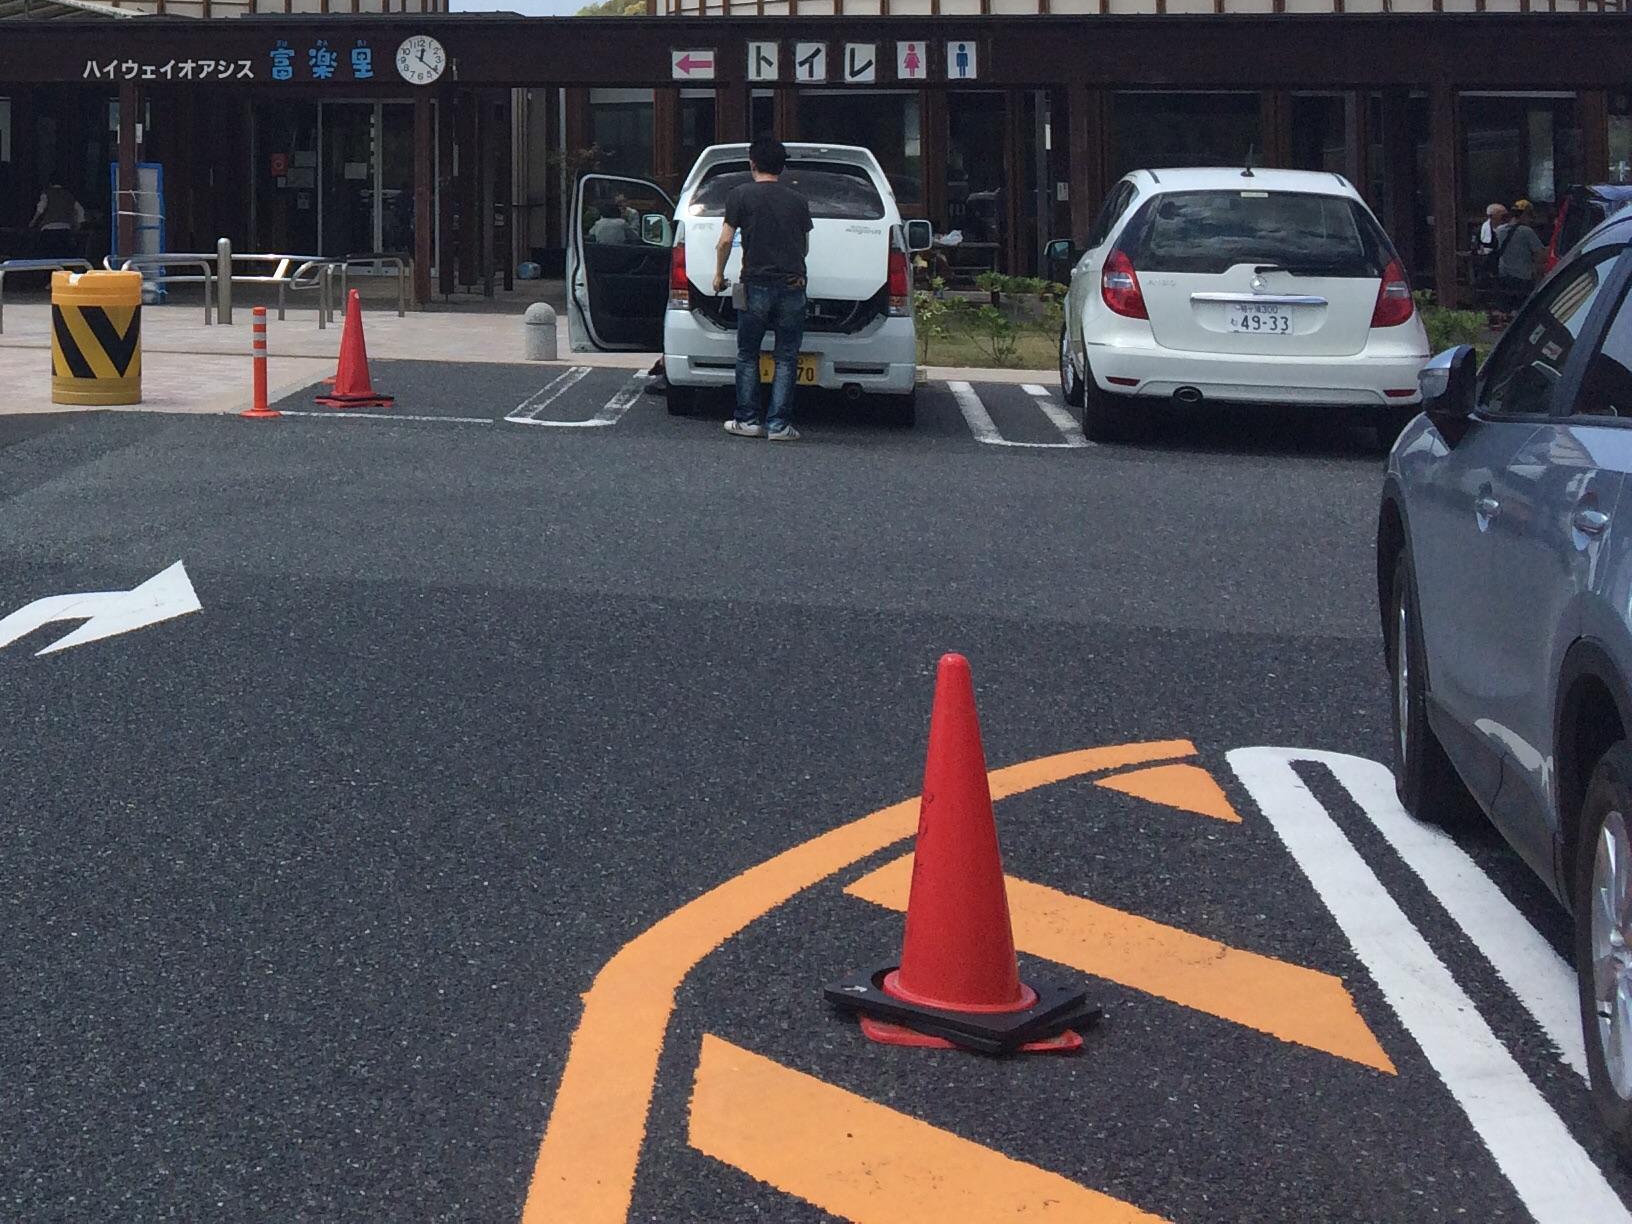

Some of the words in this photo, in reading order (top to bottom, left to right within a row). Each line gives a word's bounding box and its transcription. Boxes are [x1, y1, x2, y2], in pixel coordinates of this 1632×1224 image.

[417, 39, 426, 47] 12
[401, 47, 411, 56] 10
[82, 59, 255, 79] ハイウェイオアシス
[269, 47, 374, 81] 富楽里
[400, 56, 407, 64] 9
[435, 56, 442, 64] 3
[755, 45, 874, 79] トイレ
[403, 64, 409, 72] 8
[418, 72, 424, 80] 6
[1240, 314, 1289, 331] 49-33
